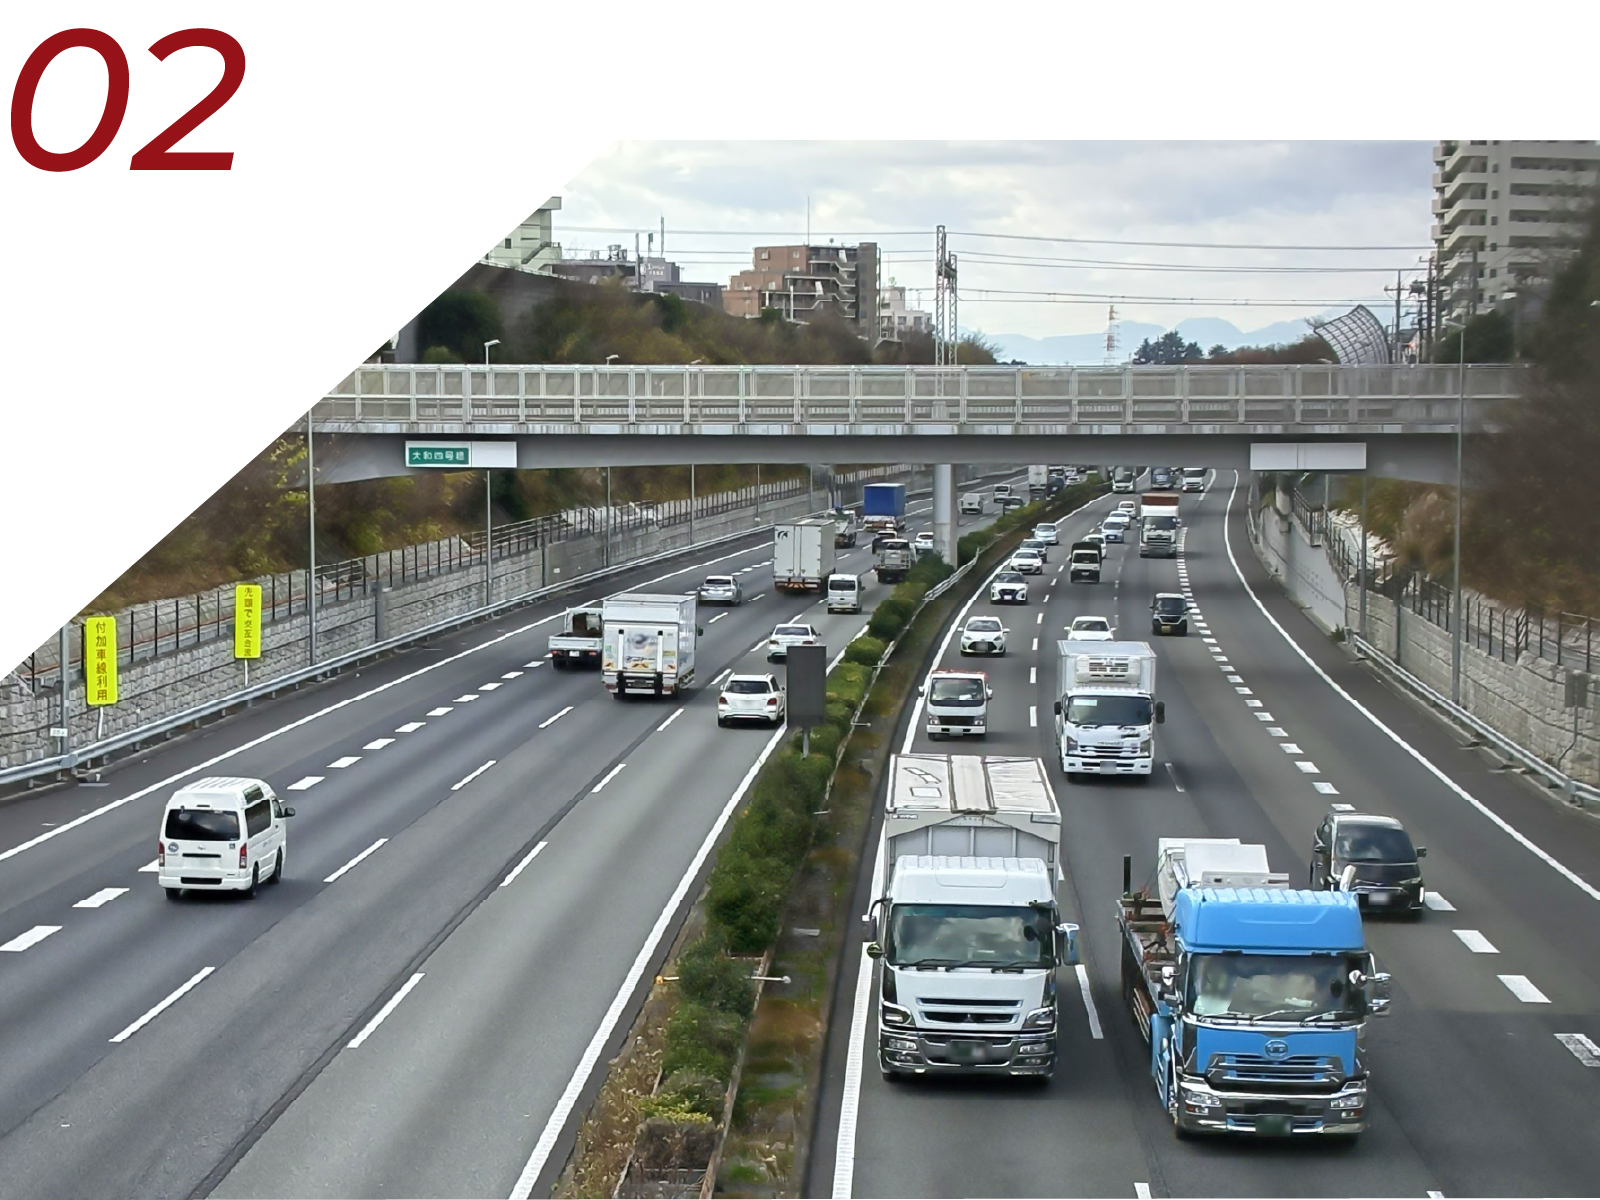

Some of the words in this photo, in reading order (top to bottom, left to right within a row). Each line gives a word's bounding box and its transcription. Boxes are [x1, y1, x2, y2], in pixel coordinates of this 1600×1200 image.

[96, 622, 107, 701] 付加車線利用
